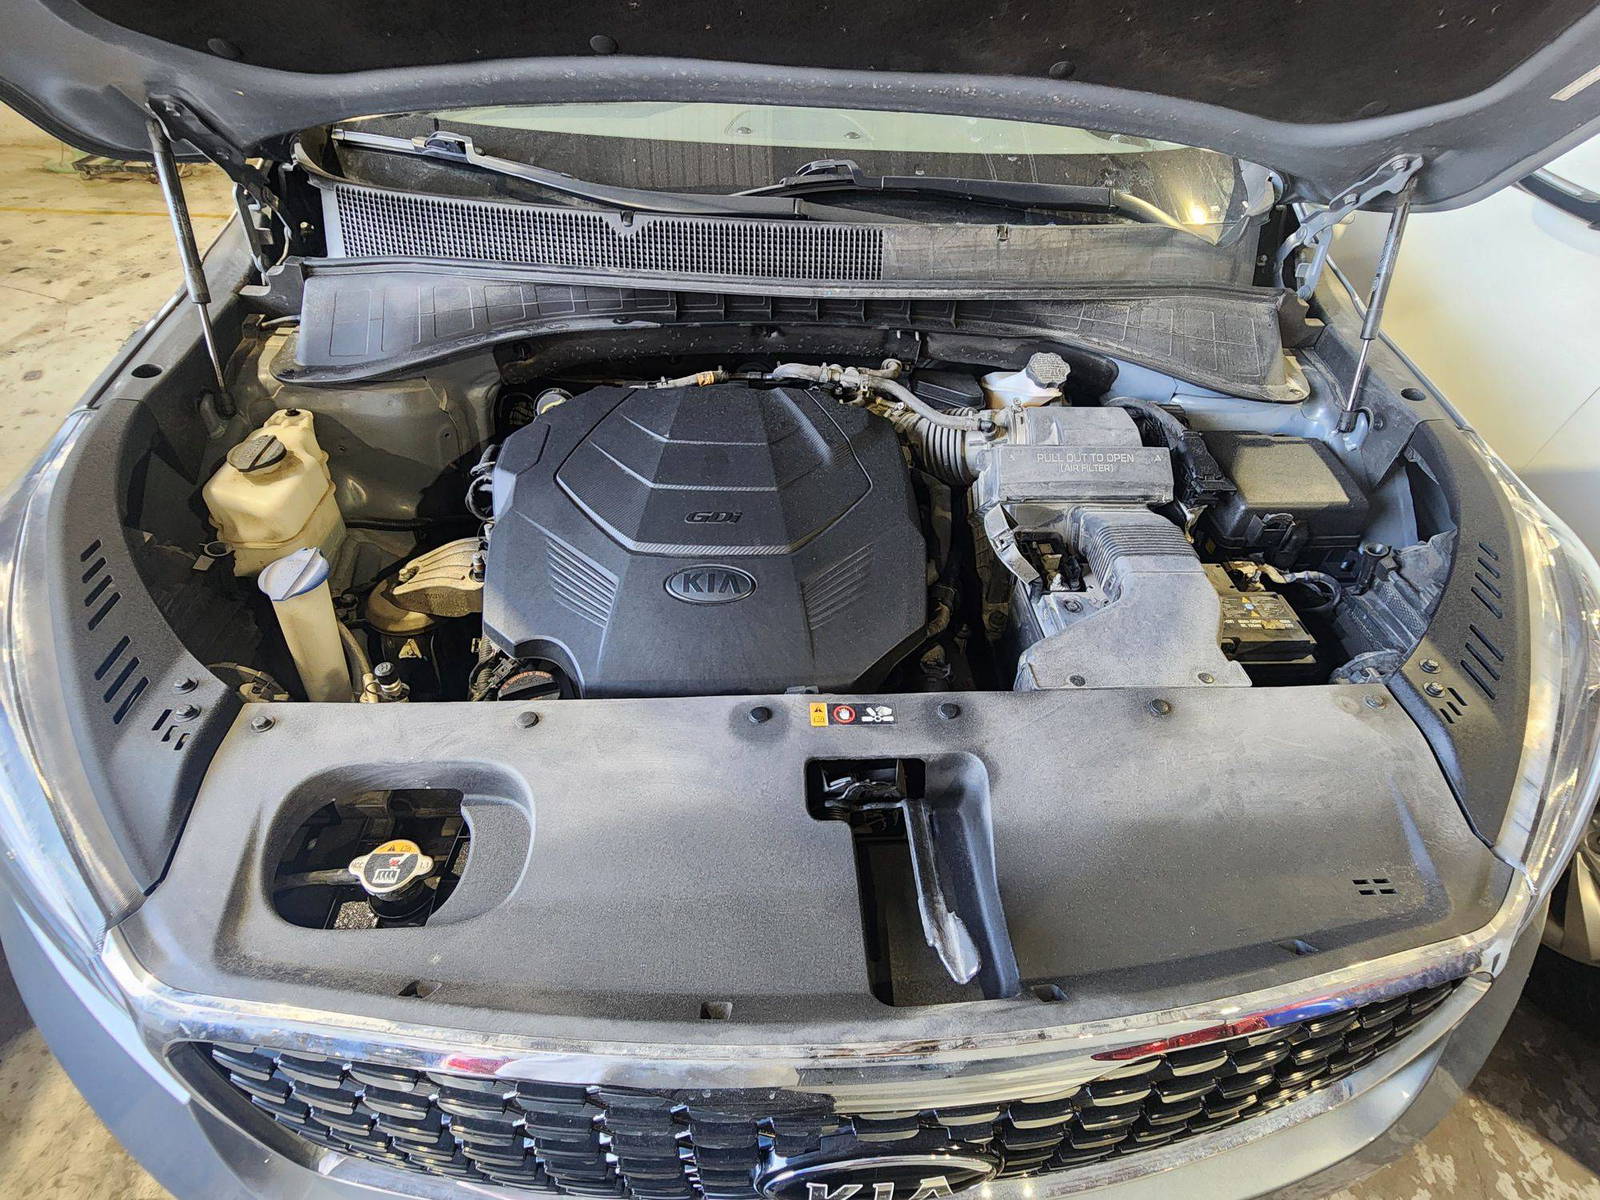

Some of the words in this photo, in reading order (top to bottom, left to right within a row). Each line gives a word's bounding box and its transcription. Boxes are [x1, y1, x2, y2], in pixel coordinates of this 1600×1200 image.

[1037, 453, 1063, 463] PULL
[1066, 453, 1088, 463] OUT
[1091, 453, 1104, 463] TO
[1106, 453, 1135, 463] OPEN
[1060, 463, 1079, 473] (AIR
[1081, 463, 1114, 473] FILTER)
[682, 574, 740, 593] KIA
